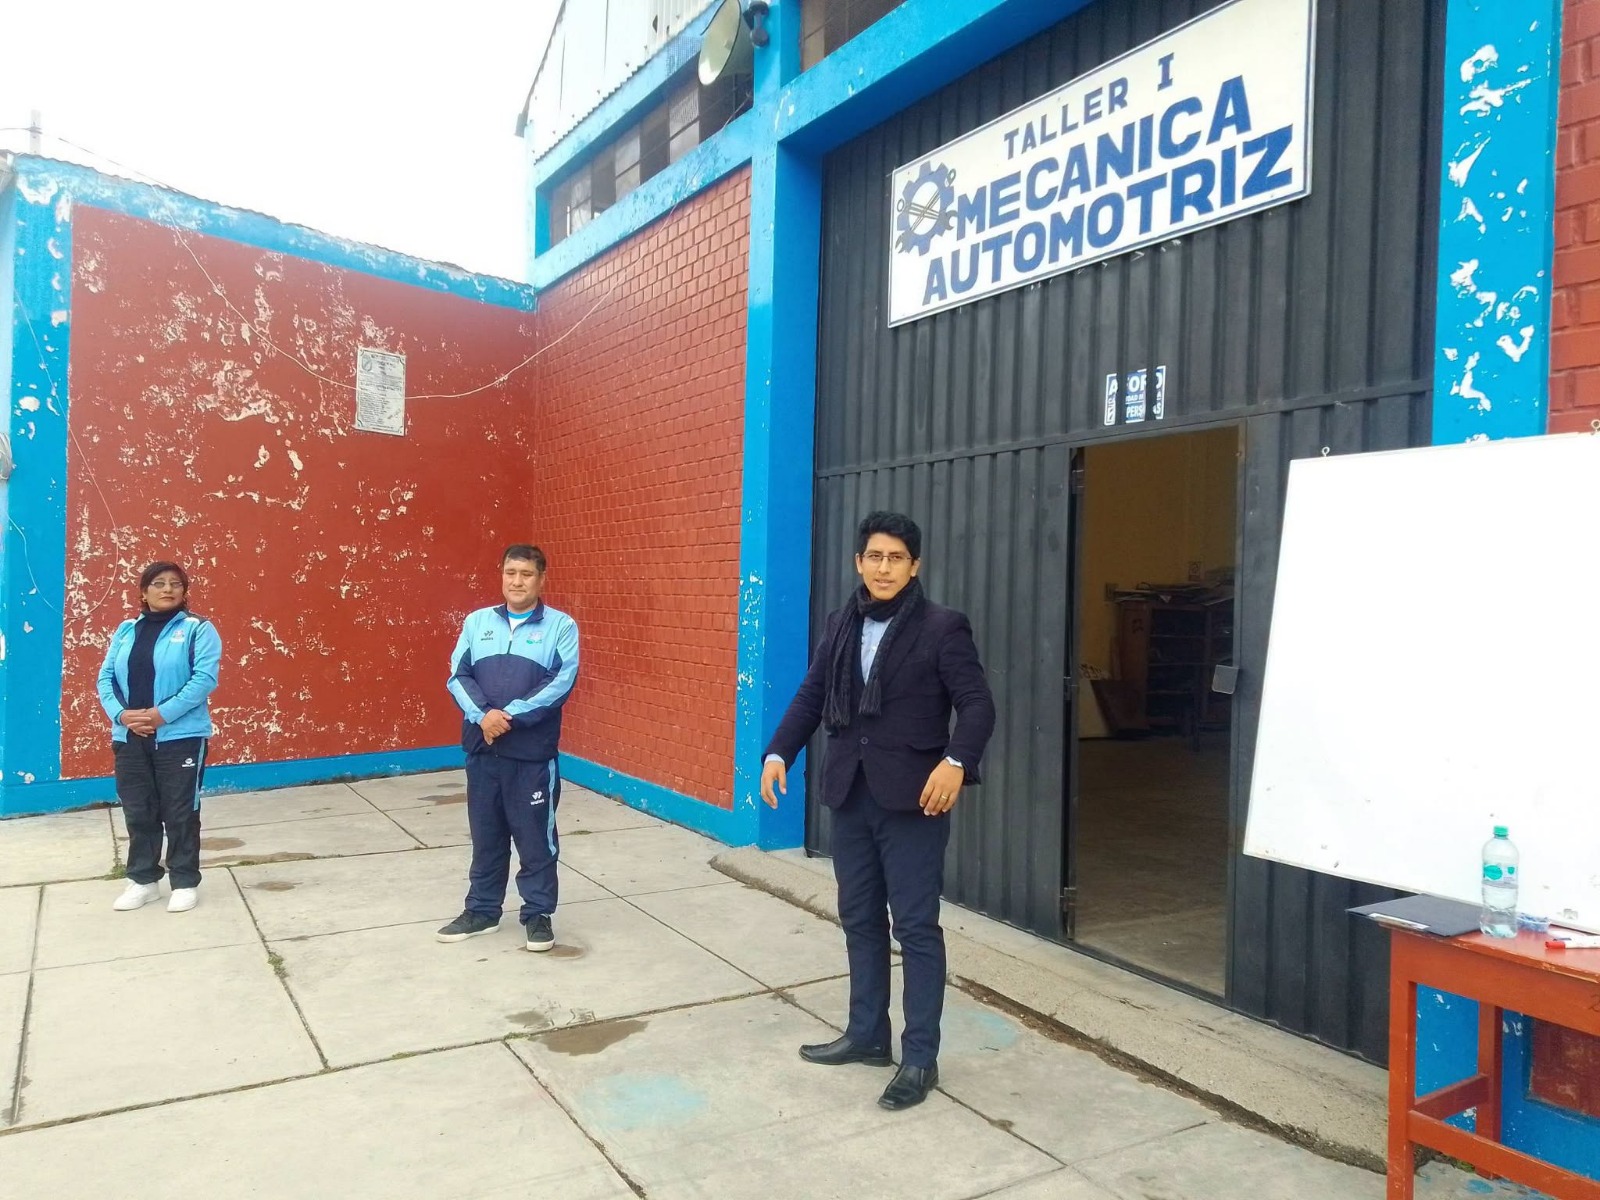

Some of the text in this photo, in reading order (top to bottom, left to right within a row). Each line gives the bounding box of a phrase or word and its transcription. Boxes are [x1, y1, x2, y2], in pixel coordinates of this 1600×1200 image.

[957, 75, 1252, 241] MECANICA
[1004, 53, 1174, 159] TALLER I
[922, 124, 1293, 305] AUTOMOTRIZ
